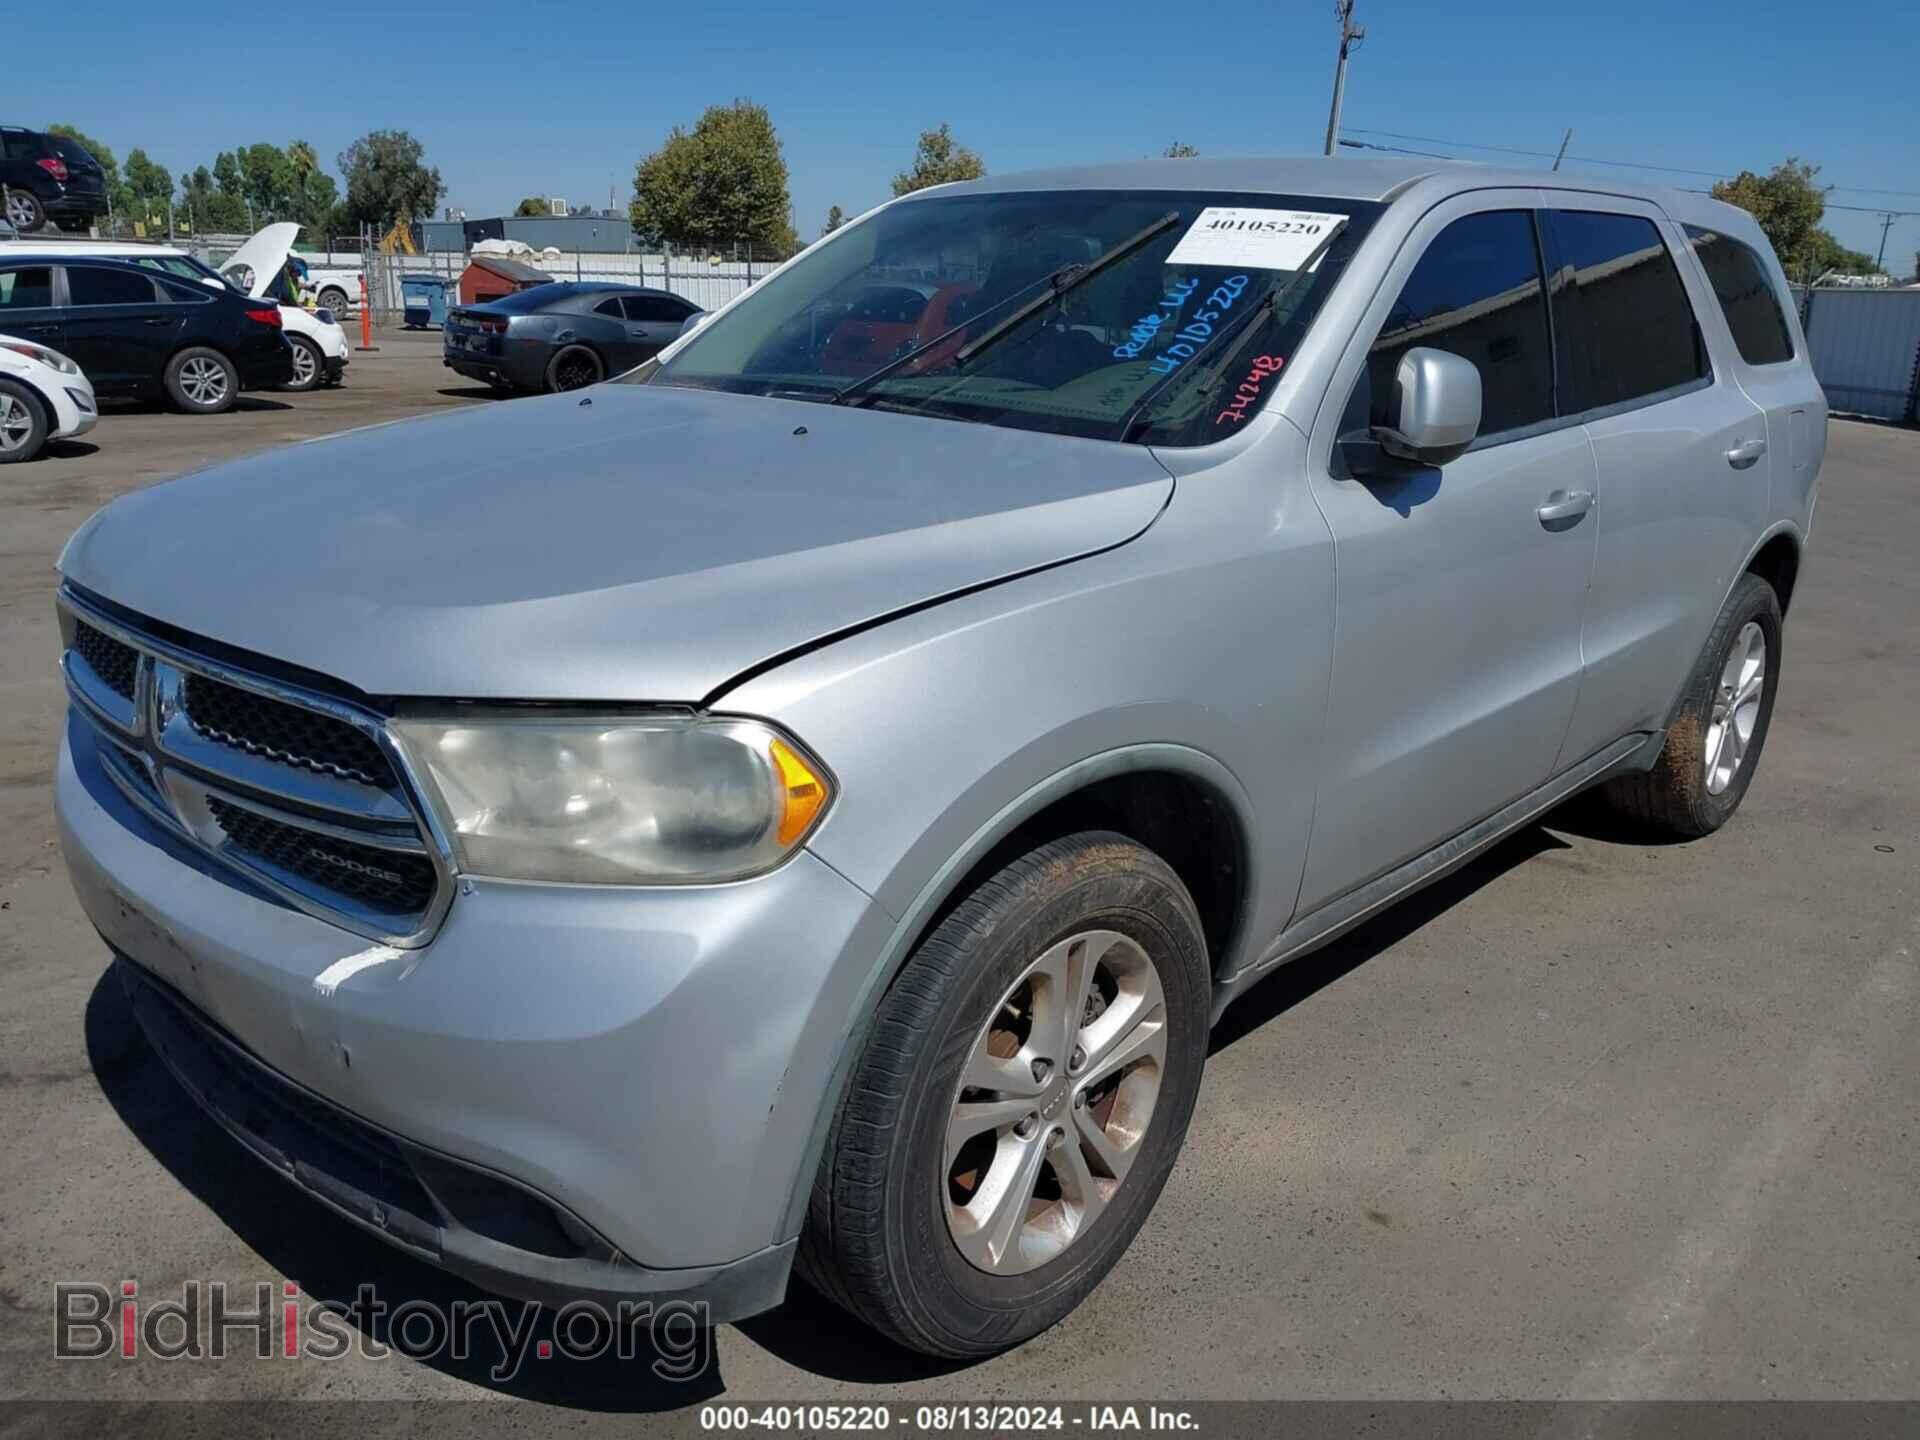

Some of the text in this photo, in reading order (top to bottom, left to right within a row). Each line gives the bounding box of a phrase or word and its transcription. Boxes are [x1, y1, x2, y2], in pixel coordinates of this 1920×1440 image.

[1206, 218, 1321, 236] 40105220
[1150, 275, 1250, 375] 40105220
[1216, 354, 1286, 425] 74248
[310, 849, 402, 883] DODGE
